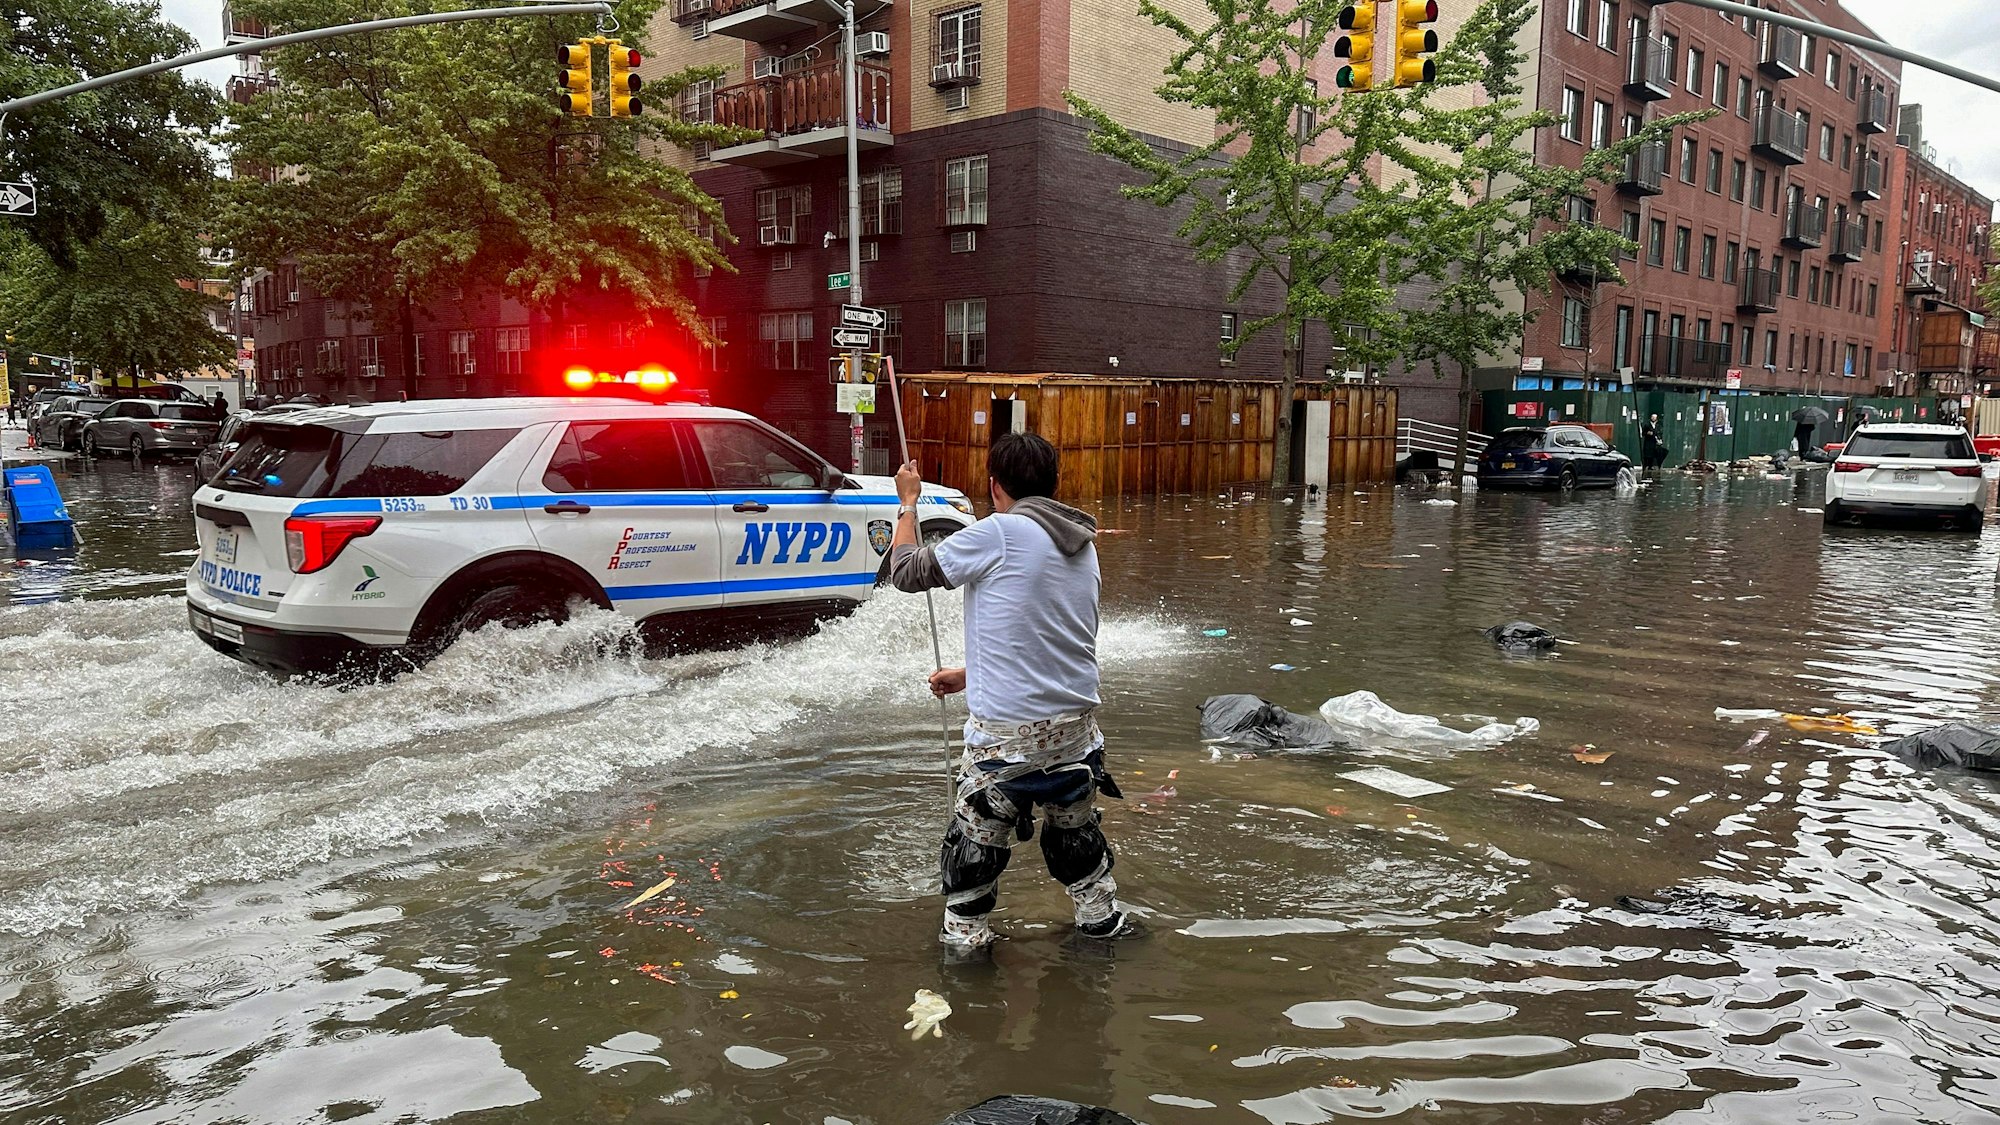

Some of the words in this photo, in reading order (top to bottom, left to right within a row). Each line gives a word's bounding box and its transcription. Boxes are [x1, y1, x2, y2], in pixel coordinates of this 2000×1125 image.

[831, 276, 842, 288] Lee
[847, 311, 861, 320] ONE
[866, 314, 879, 323] WAY
[839, 333, 850, 342] ONE
[449, 497, 468, 510] TD
[472, 496, 489, 510] 30
[623, 527, 671, 541] COURTESY
[615, 541, 697, 555] PROFESSIONALISM
[736, 522, 852, 565] NYPD
[607, 556, 652, 570] RESPECT
[220, 566, 262, 597] POLICE
[351, 591, 386, 601] HYBRID
